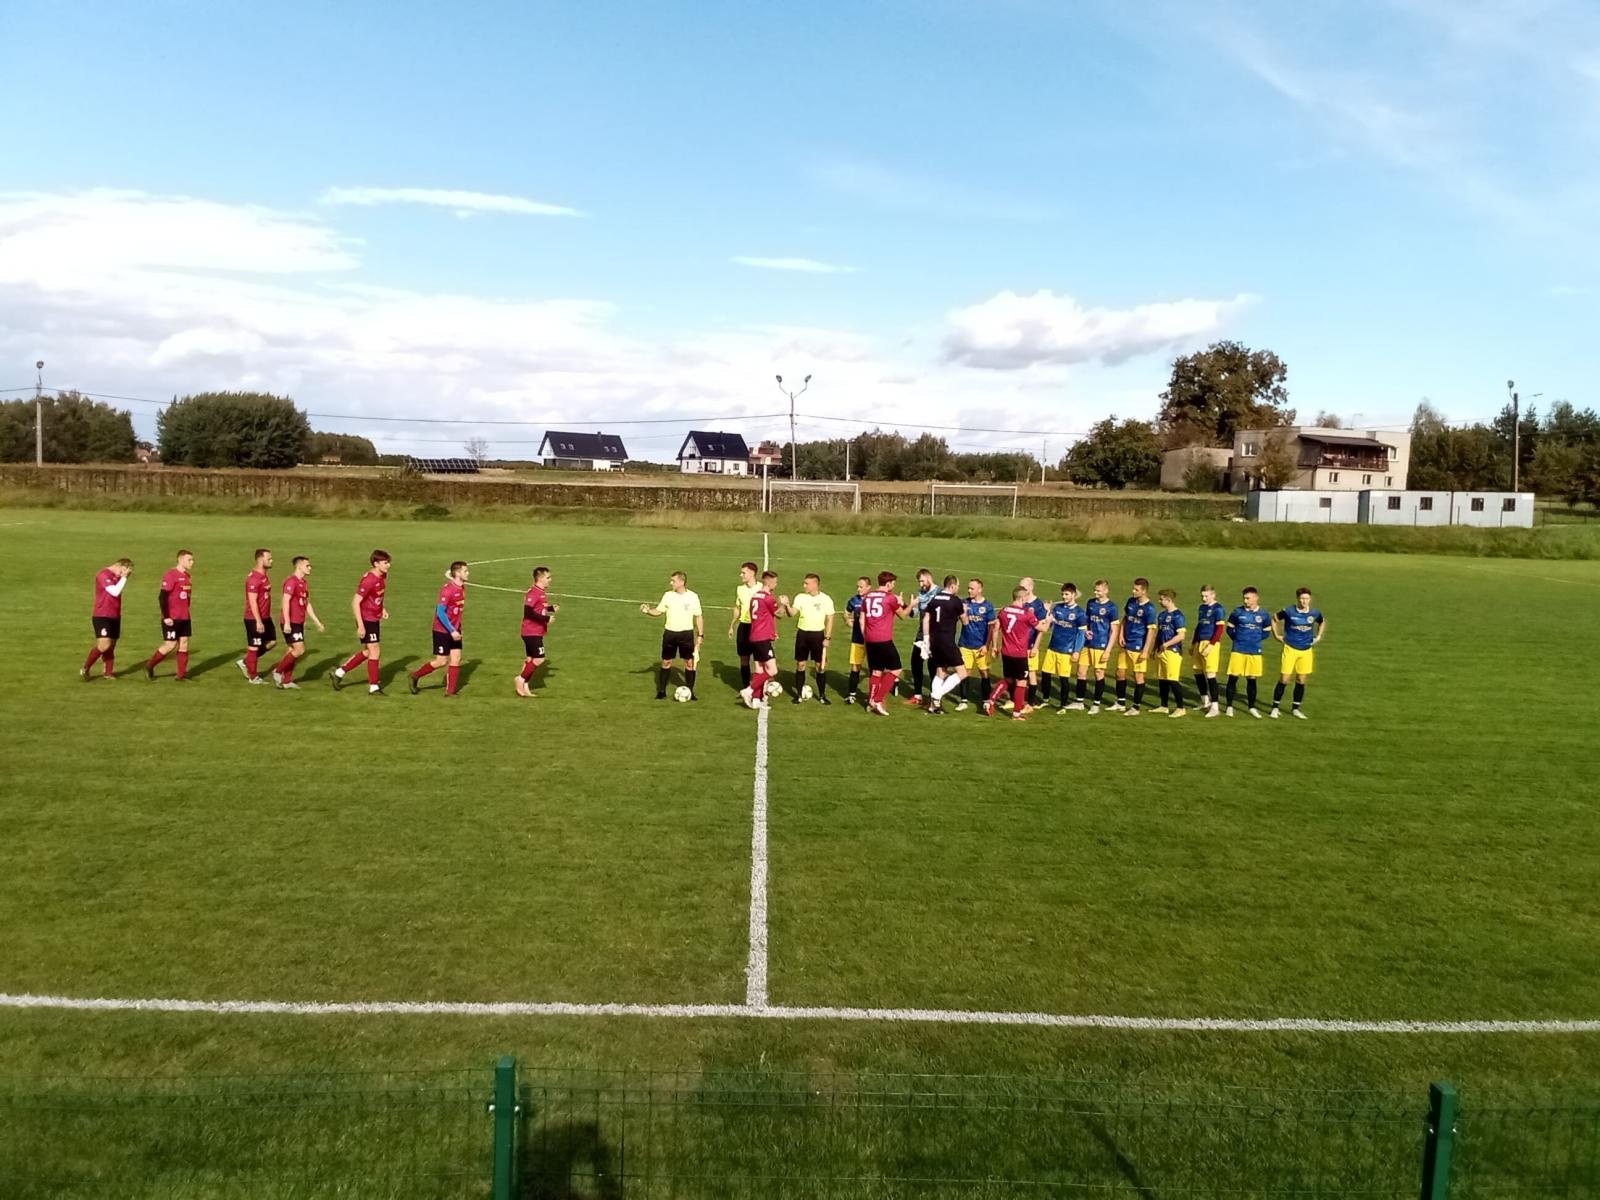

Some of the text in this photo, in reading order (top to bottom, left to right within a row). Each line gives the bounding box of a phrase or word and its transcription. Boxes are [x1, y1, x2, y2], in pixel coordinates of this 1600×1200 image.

[752, 599, 759, 619] 2
[865, 597, 883, 617] 15
[935, 606, 941, 622] 1
[101, 628, 107, 636] 6
[1006, 614, 1016, 633] 7
[167, 631, 176, 639] 14
